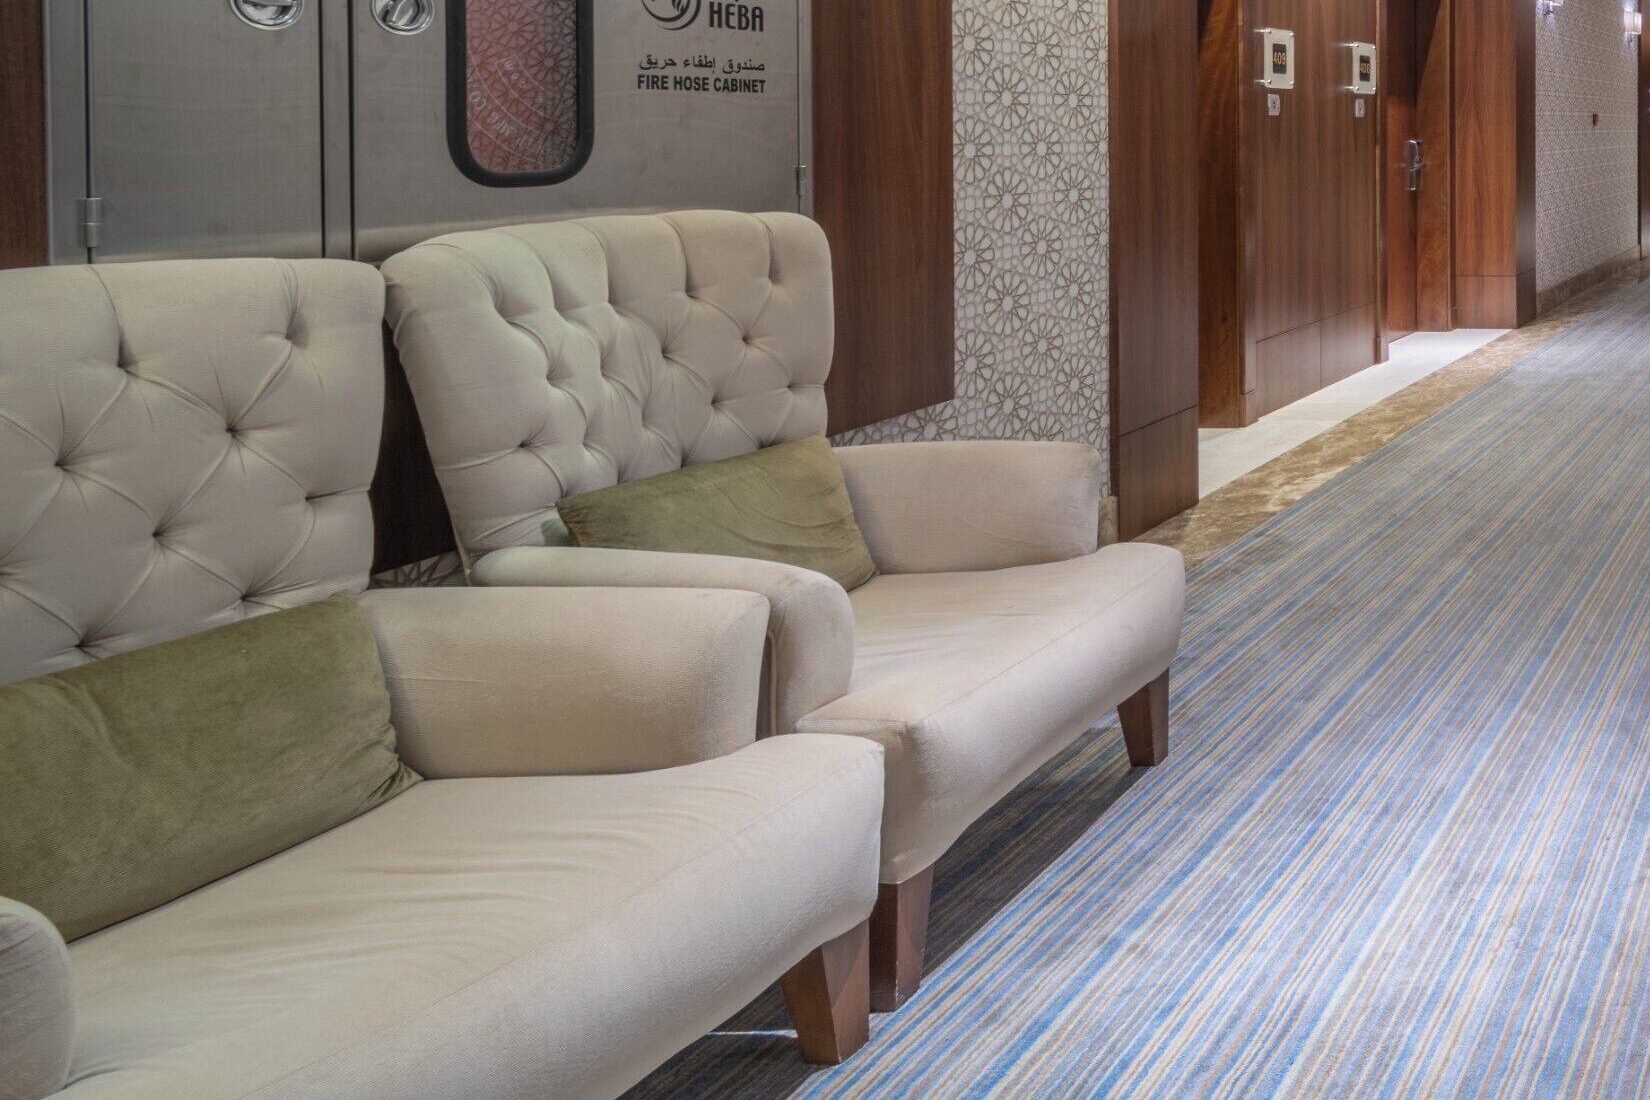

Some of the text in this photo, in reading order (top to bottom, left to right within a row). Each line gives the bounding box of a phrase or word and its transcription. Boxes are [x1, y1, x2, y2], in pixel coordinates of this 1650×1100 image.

[709, 1, 764, 32] HEBA
[639, 53, 677, 70] حريق
[722, 58, 765, 75] صندوق
[637, 74, 766, 94] FIRE HOSE CABINET
